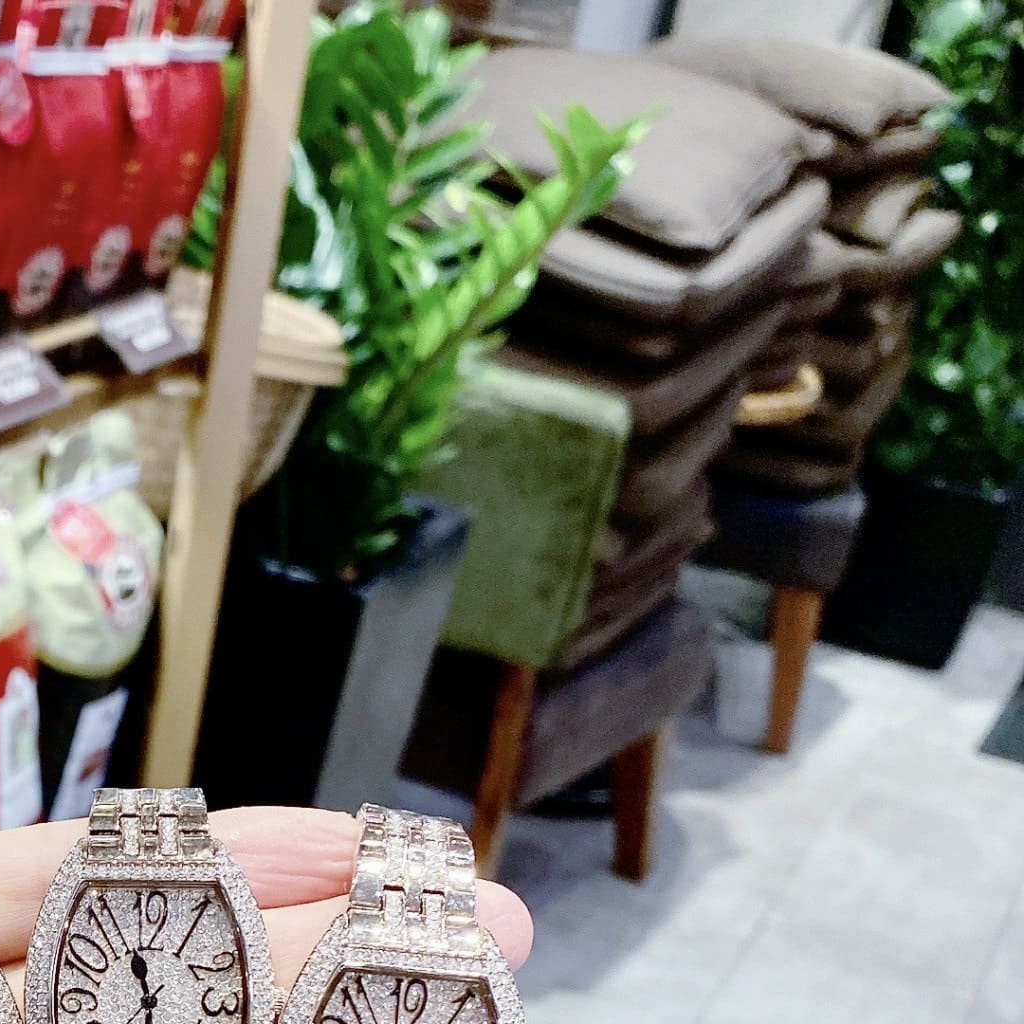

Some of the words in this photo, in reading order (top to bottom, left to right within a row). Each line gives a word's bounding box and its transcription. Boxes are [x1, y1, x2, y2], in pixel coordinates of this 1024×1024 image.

[88, 894, 131, 961] 11
[133, 891, 168, 951] 12
[173, 895, 215, 958] 1
[65, 933, 109, 989] 10
[188, 951, 236, 981] 2
[60, 987, 98, 1014] 9
[201, 987, 239, 1017] 3
